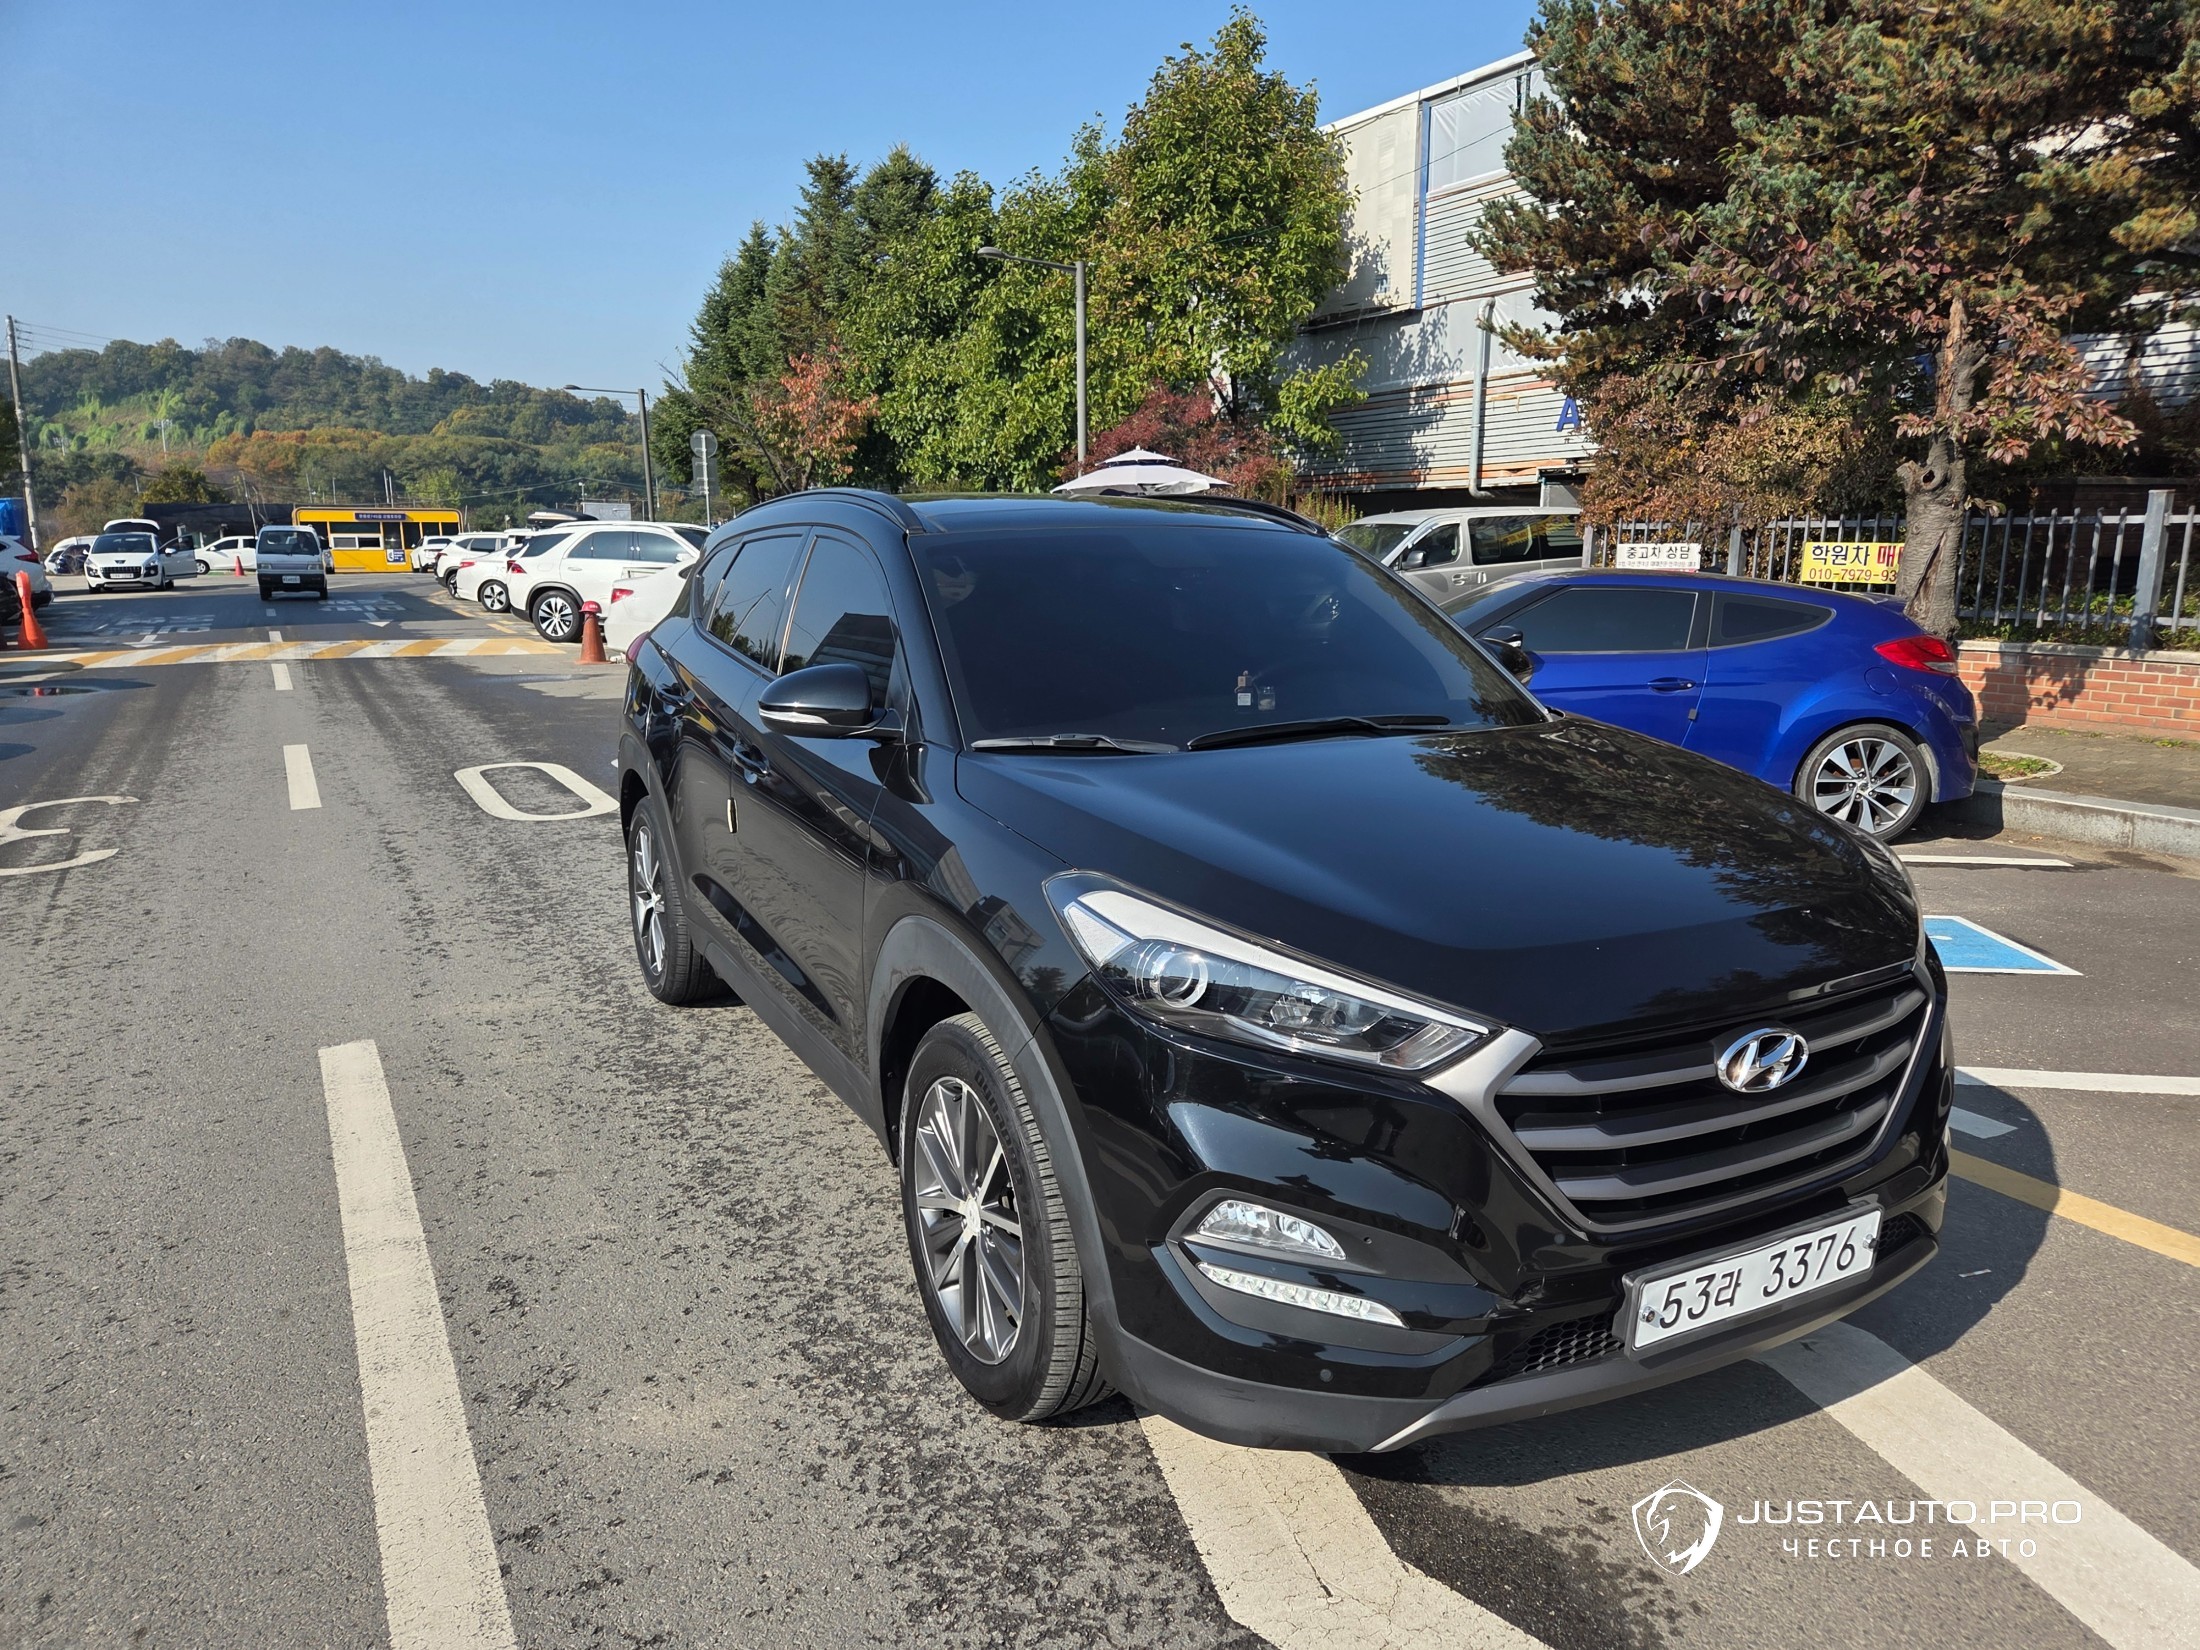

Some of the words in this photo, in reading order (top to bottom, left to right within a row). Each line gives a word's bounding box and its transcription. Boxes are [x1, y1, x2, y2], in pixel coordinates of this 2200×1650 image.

[1627, 546, 1661, 560] 중고차
[1666, 546, 1690, 560] 상담
[1812, 544, 1870, 566] 학원차
[1659, 1267, 1743, 1330] 53라
[1762, 1225, 1857, 1299] 3376
